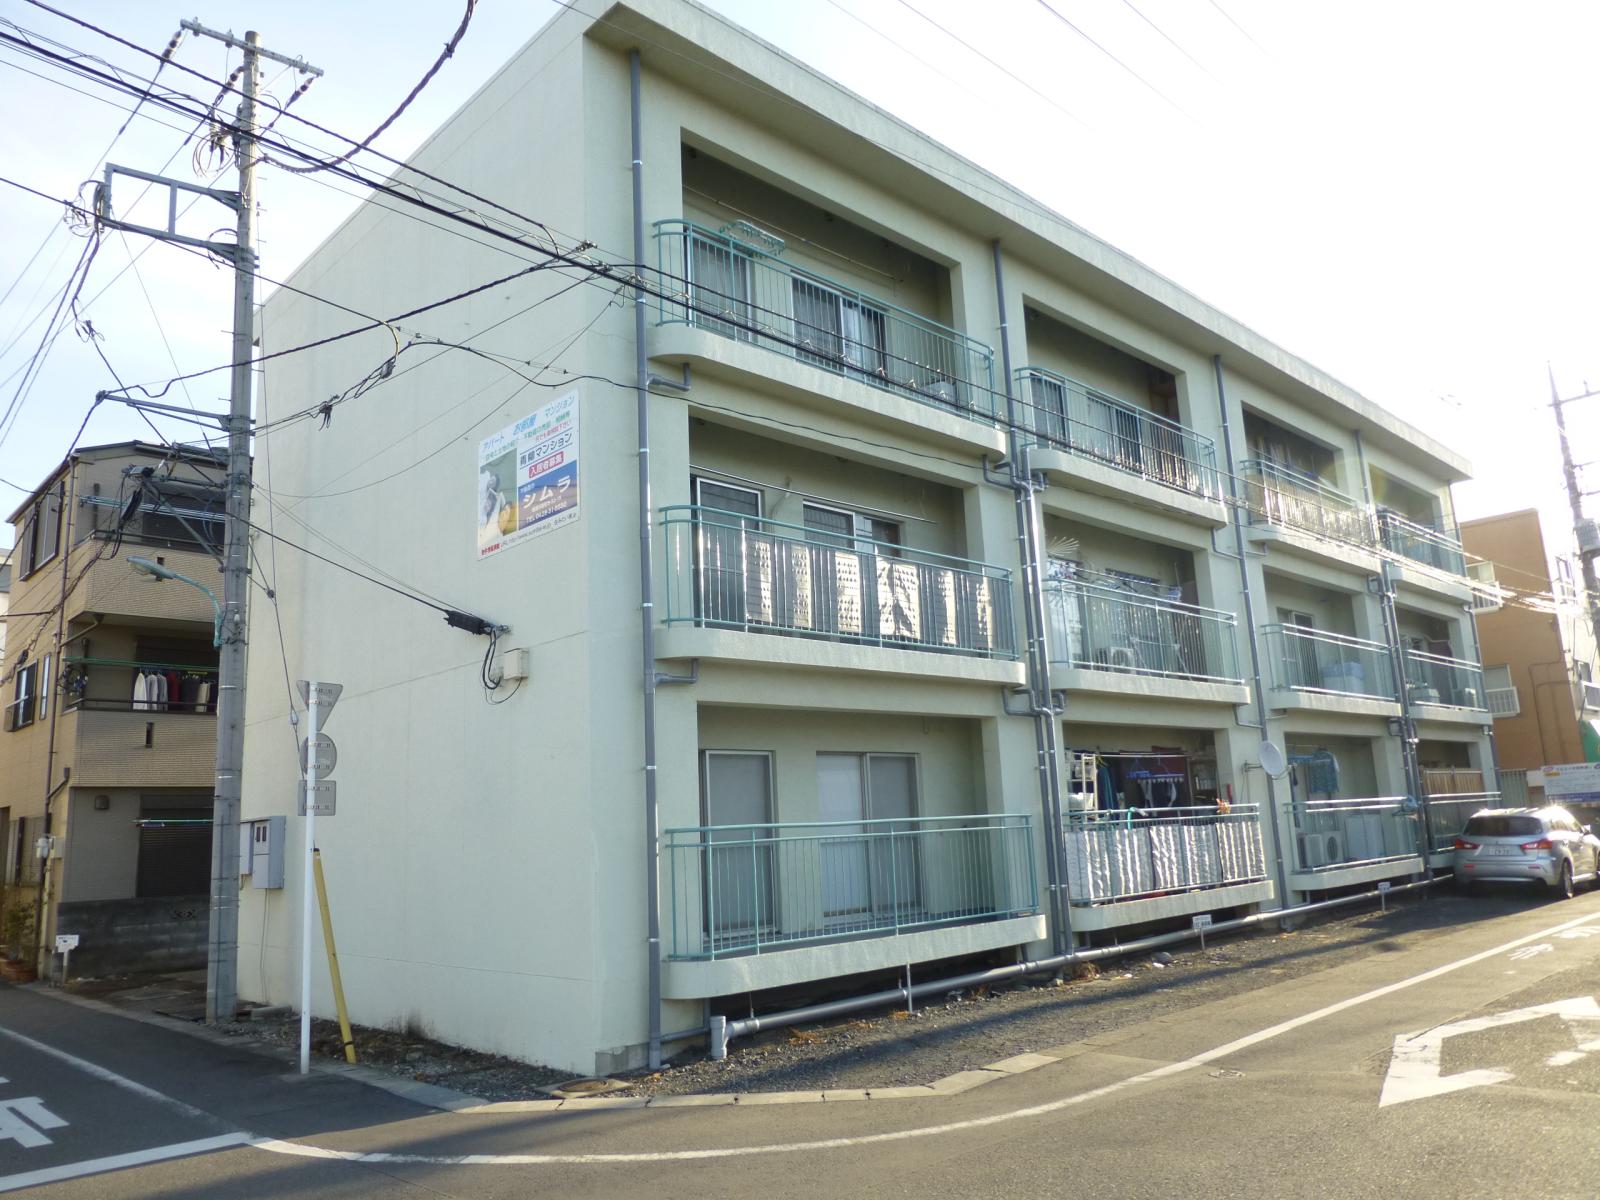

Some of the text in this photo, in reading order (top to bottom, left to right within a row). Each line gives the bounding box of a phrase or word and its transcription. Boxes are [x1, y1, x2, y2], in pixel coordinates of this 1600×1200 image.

[545, 396, 575, 418] マンション
[522, 475, 571, 510] シムラ
